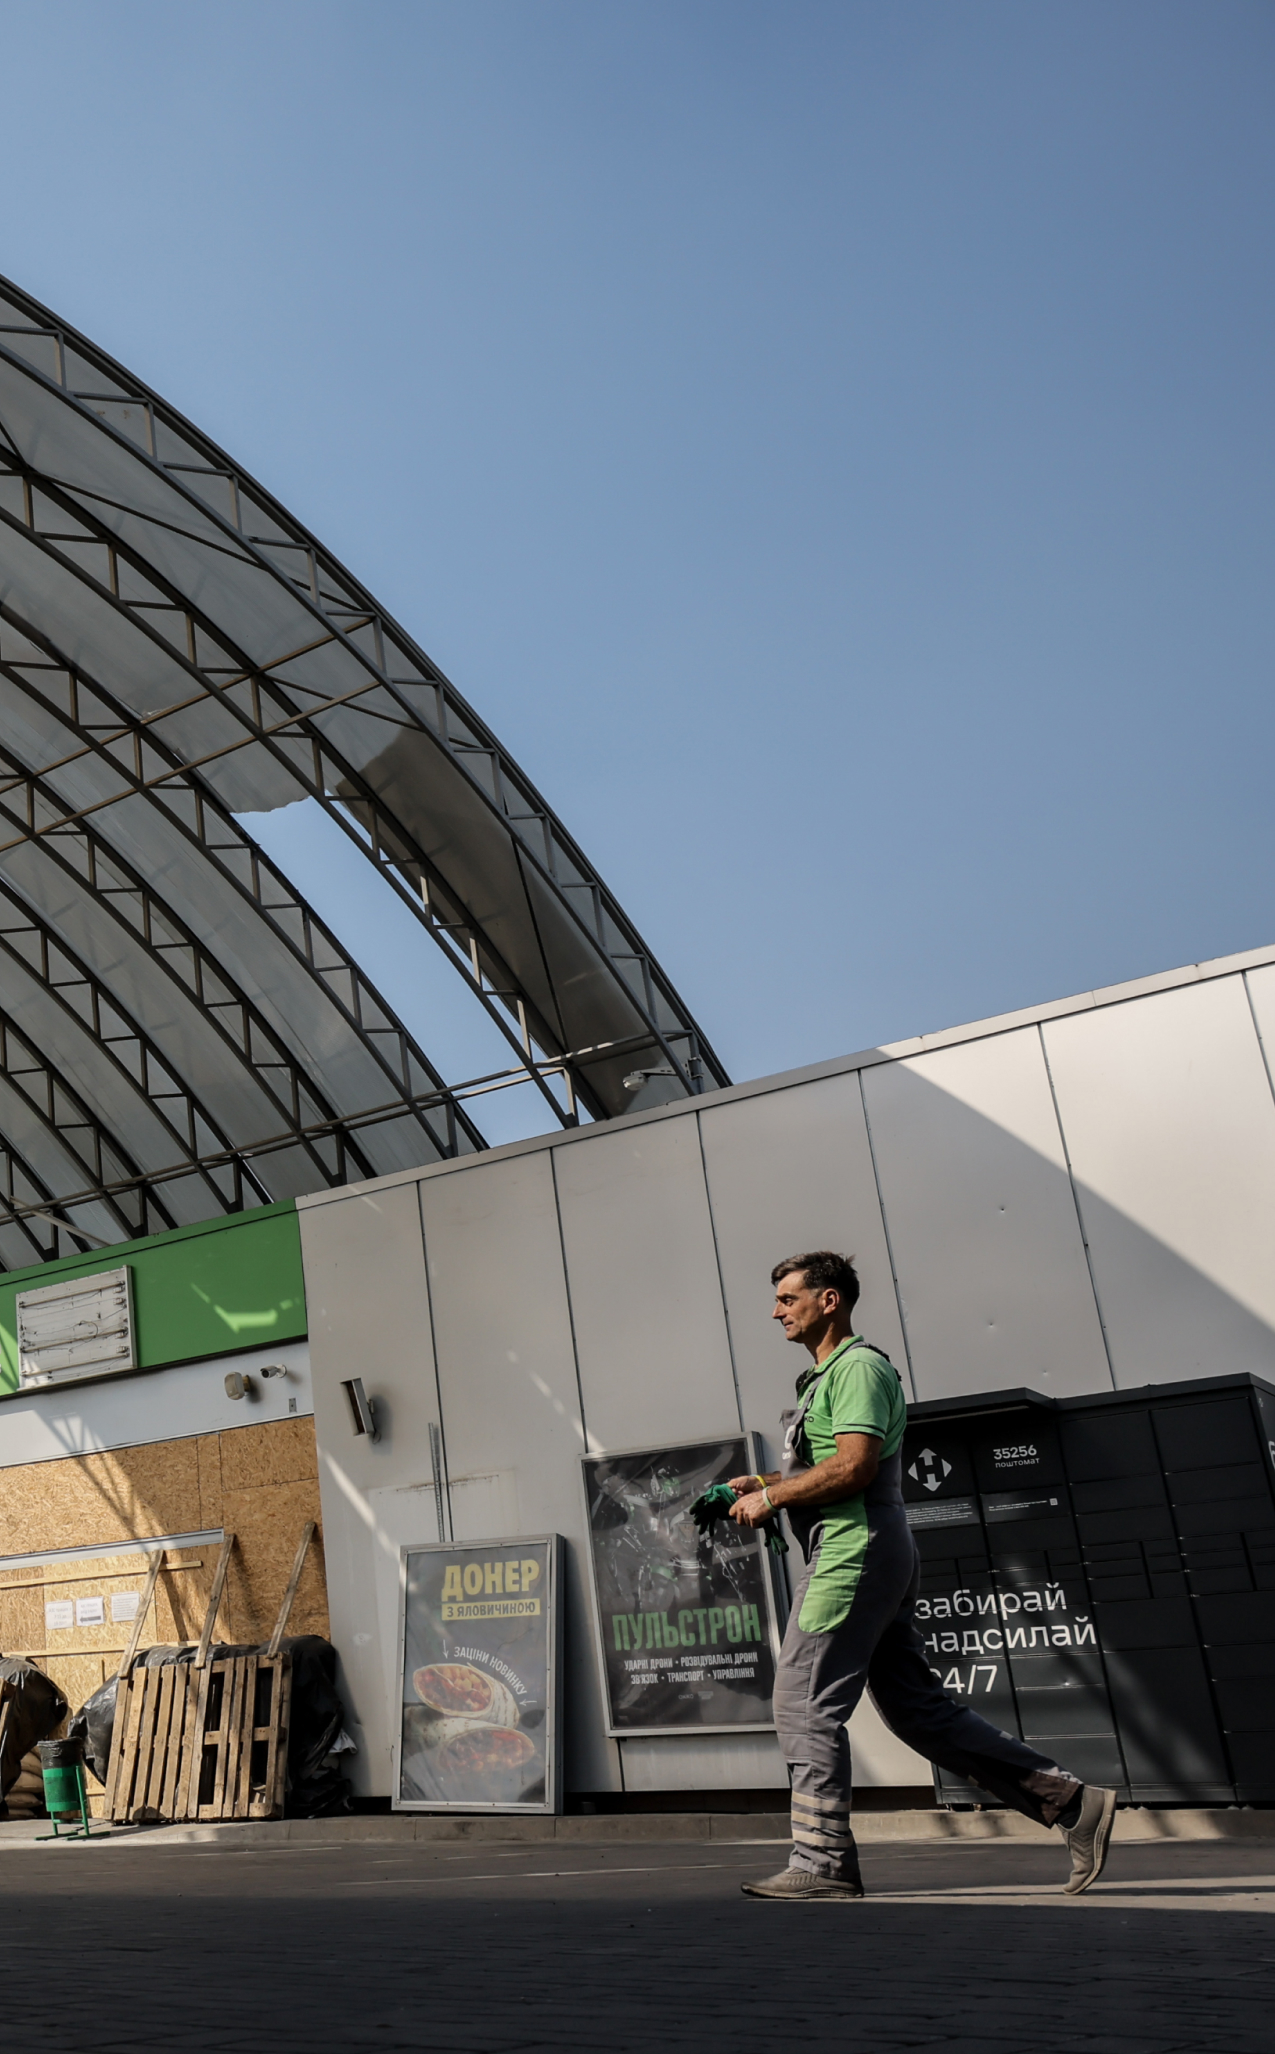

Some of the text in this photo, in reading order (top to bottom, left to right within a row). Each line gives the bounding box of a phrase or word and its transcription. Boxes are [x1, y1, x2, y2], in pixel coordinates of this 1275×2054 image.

[993, 1444, 1037, 1460] 35256
[995, 1457, 1040, 1469] поштомат
[441, 1559, 540, 1602] ДОНЕР
[446, 1601, 536, 1618] З ЯЛОВИЧИНОЮ
[914, 1582, 1067, 1620] забирай
[612, 1603, 762, 1651] ПУЛЬСТРОН
[453, 1646, 528, 1696] ЗАЦІНИ НОВИНКУ
[624, 1652, 759, 1672] УДАРНІ ДРОНИ РОЗВІДУВАЛЬНІ ДРОНИ
[666, 1670, 705, 1683] ТРАНСПОРТ
[711, 1667, 756, 1680] УПРАВЛІННЯ
[929, 1664, 998, 1695] 4/7
